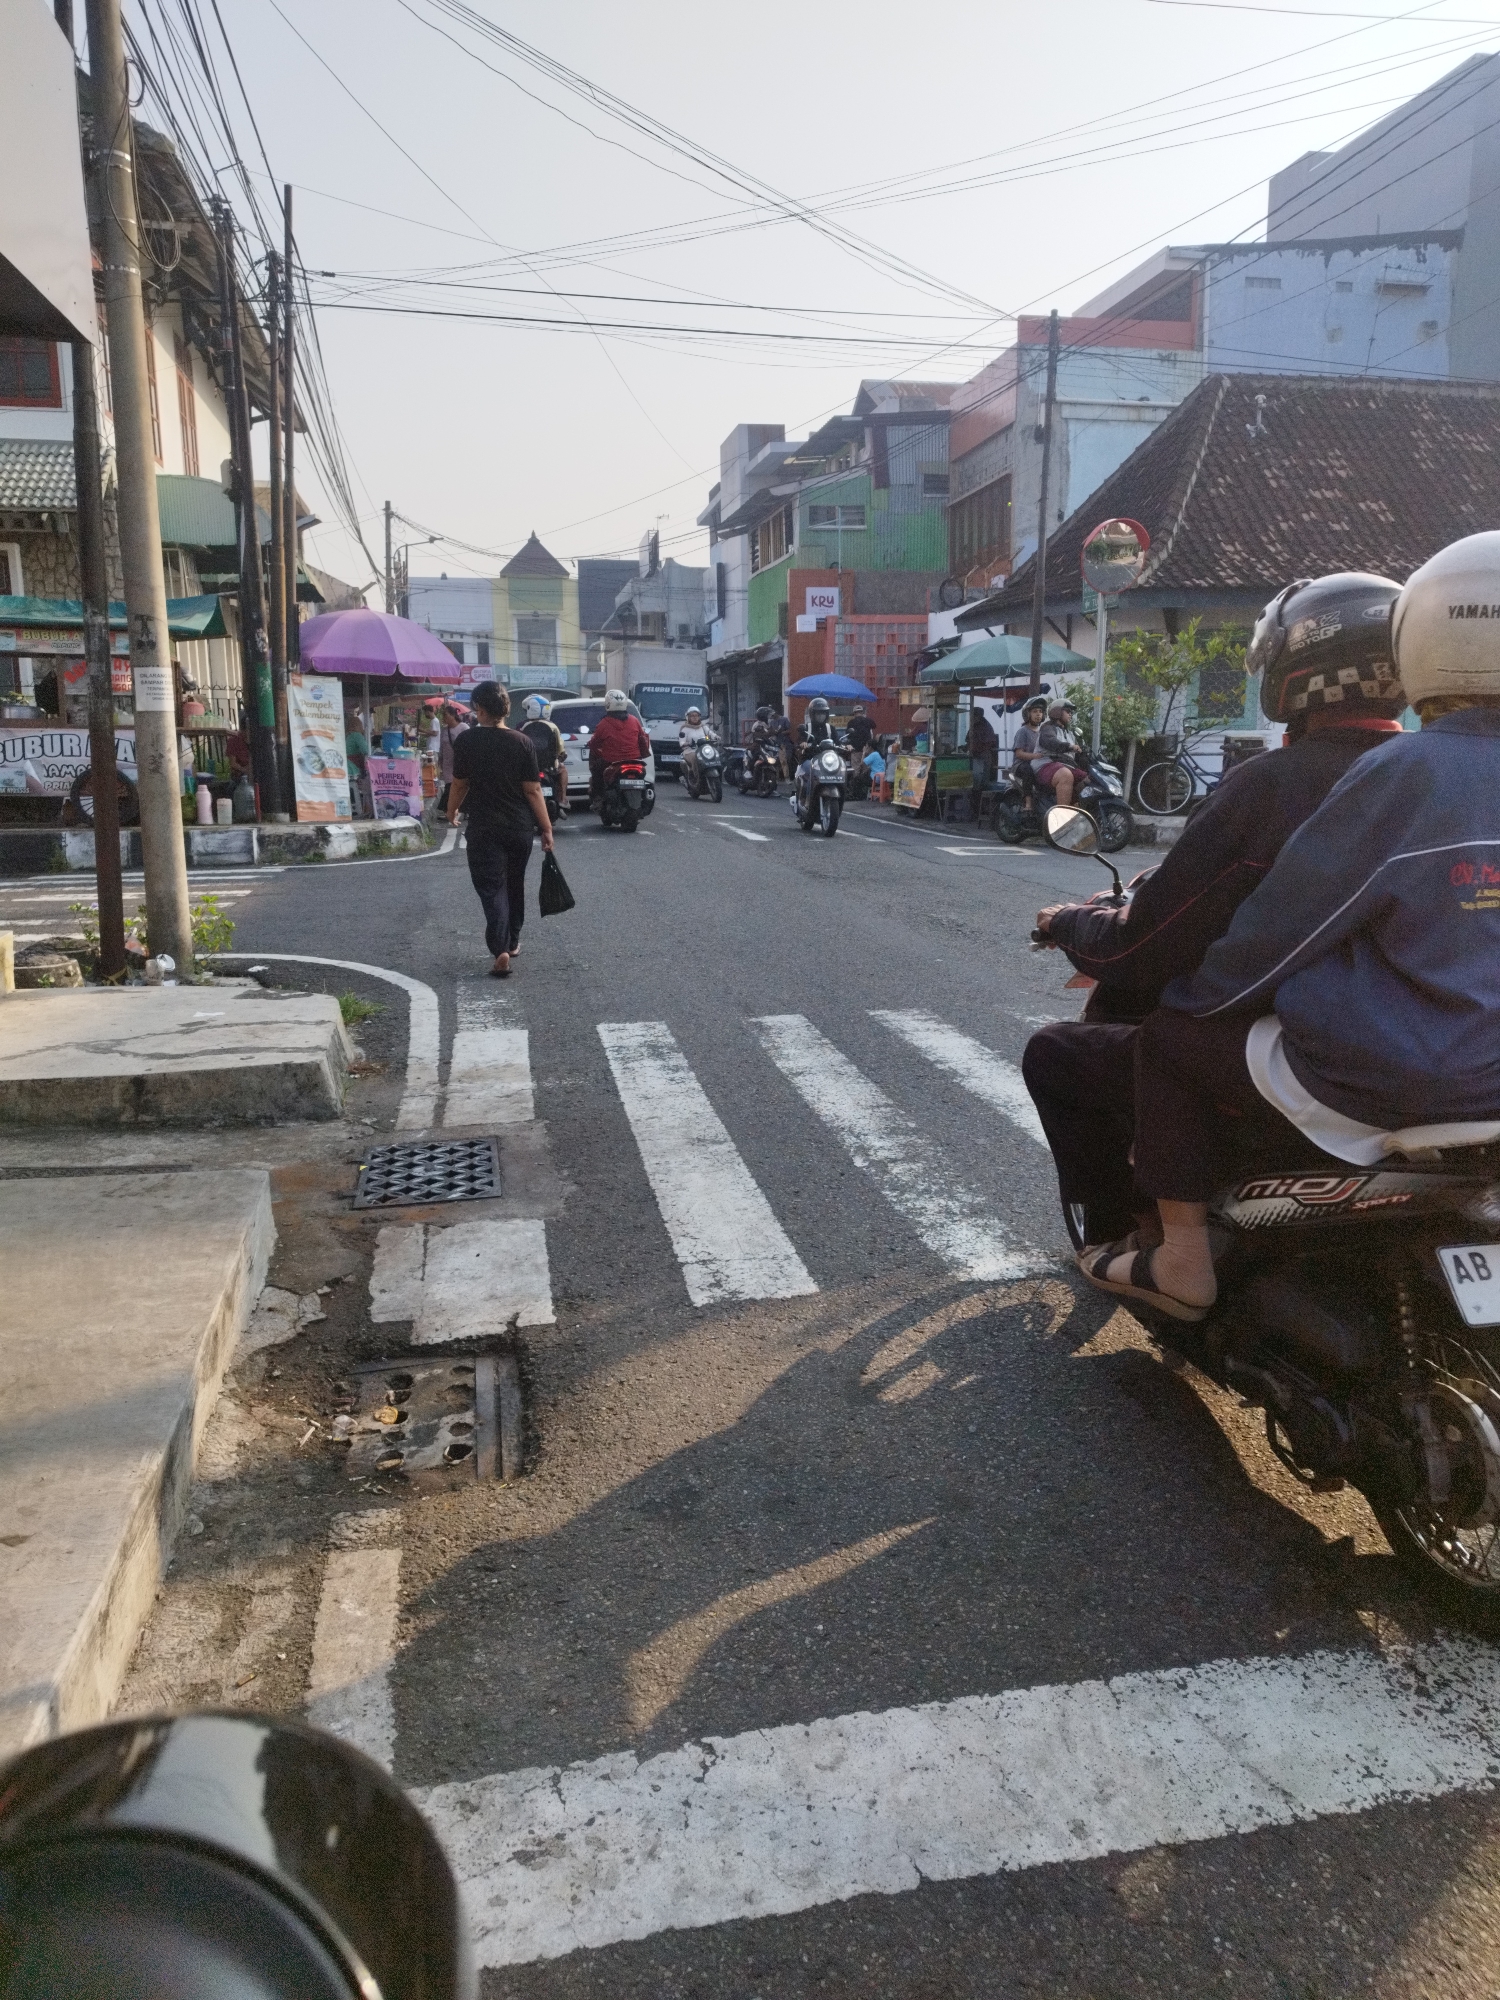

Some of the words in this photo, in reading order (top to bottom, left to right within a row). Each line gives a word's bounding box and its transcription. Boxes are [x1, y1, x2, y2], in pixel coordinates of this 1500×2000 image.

[811, 595, 835, 608] KRU
[22, 631, 68, 640] BUBUR
[301, 700, 334, 712] Pempek
[0, 733, 82, 765] UBUR
[1452, 1251, 1493, 1285] AB
